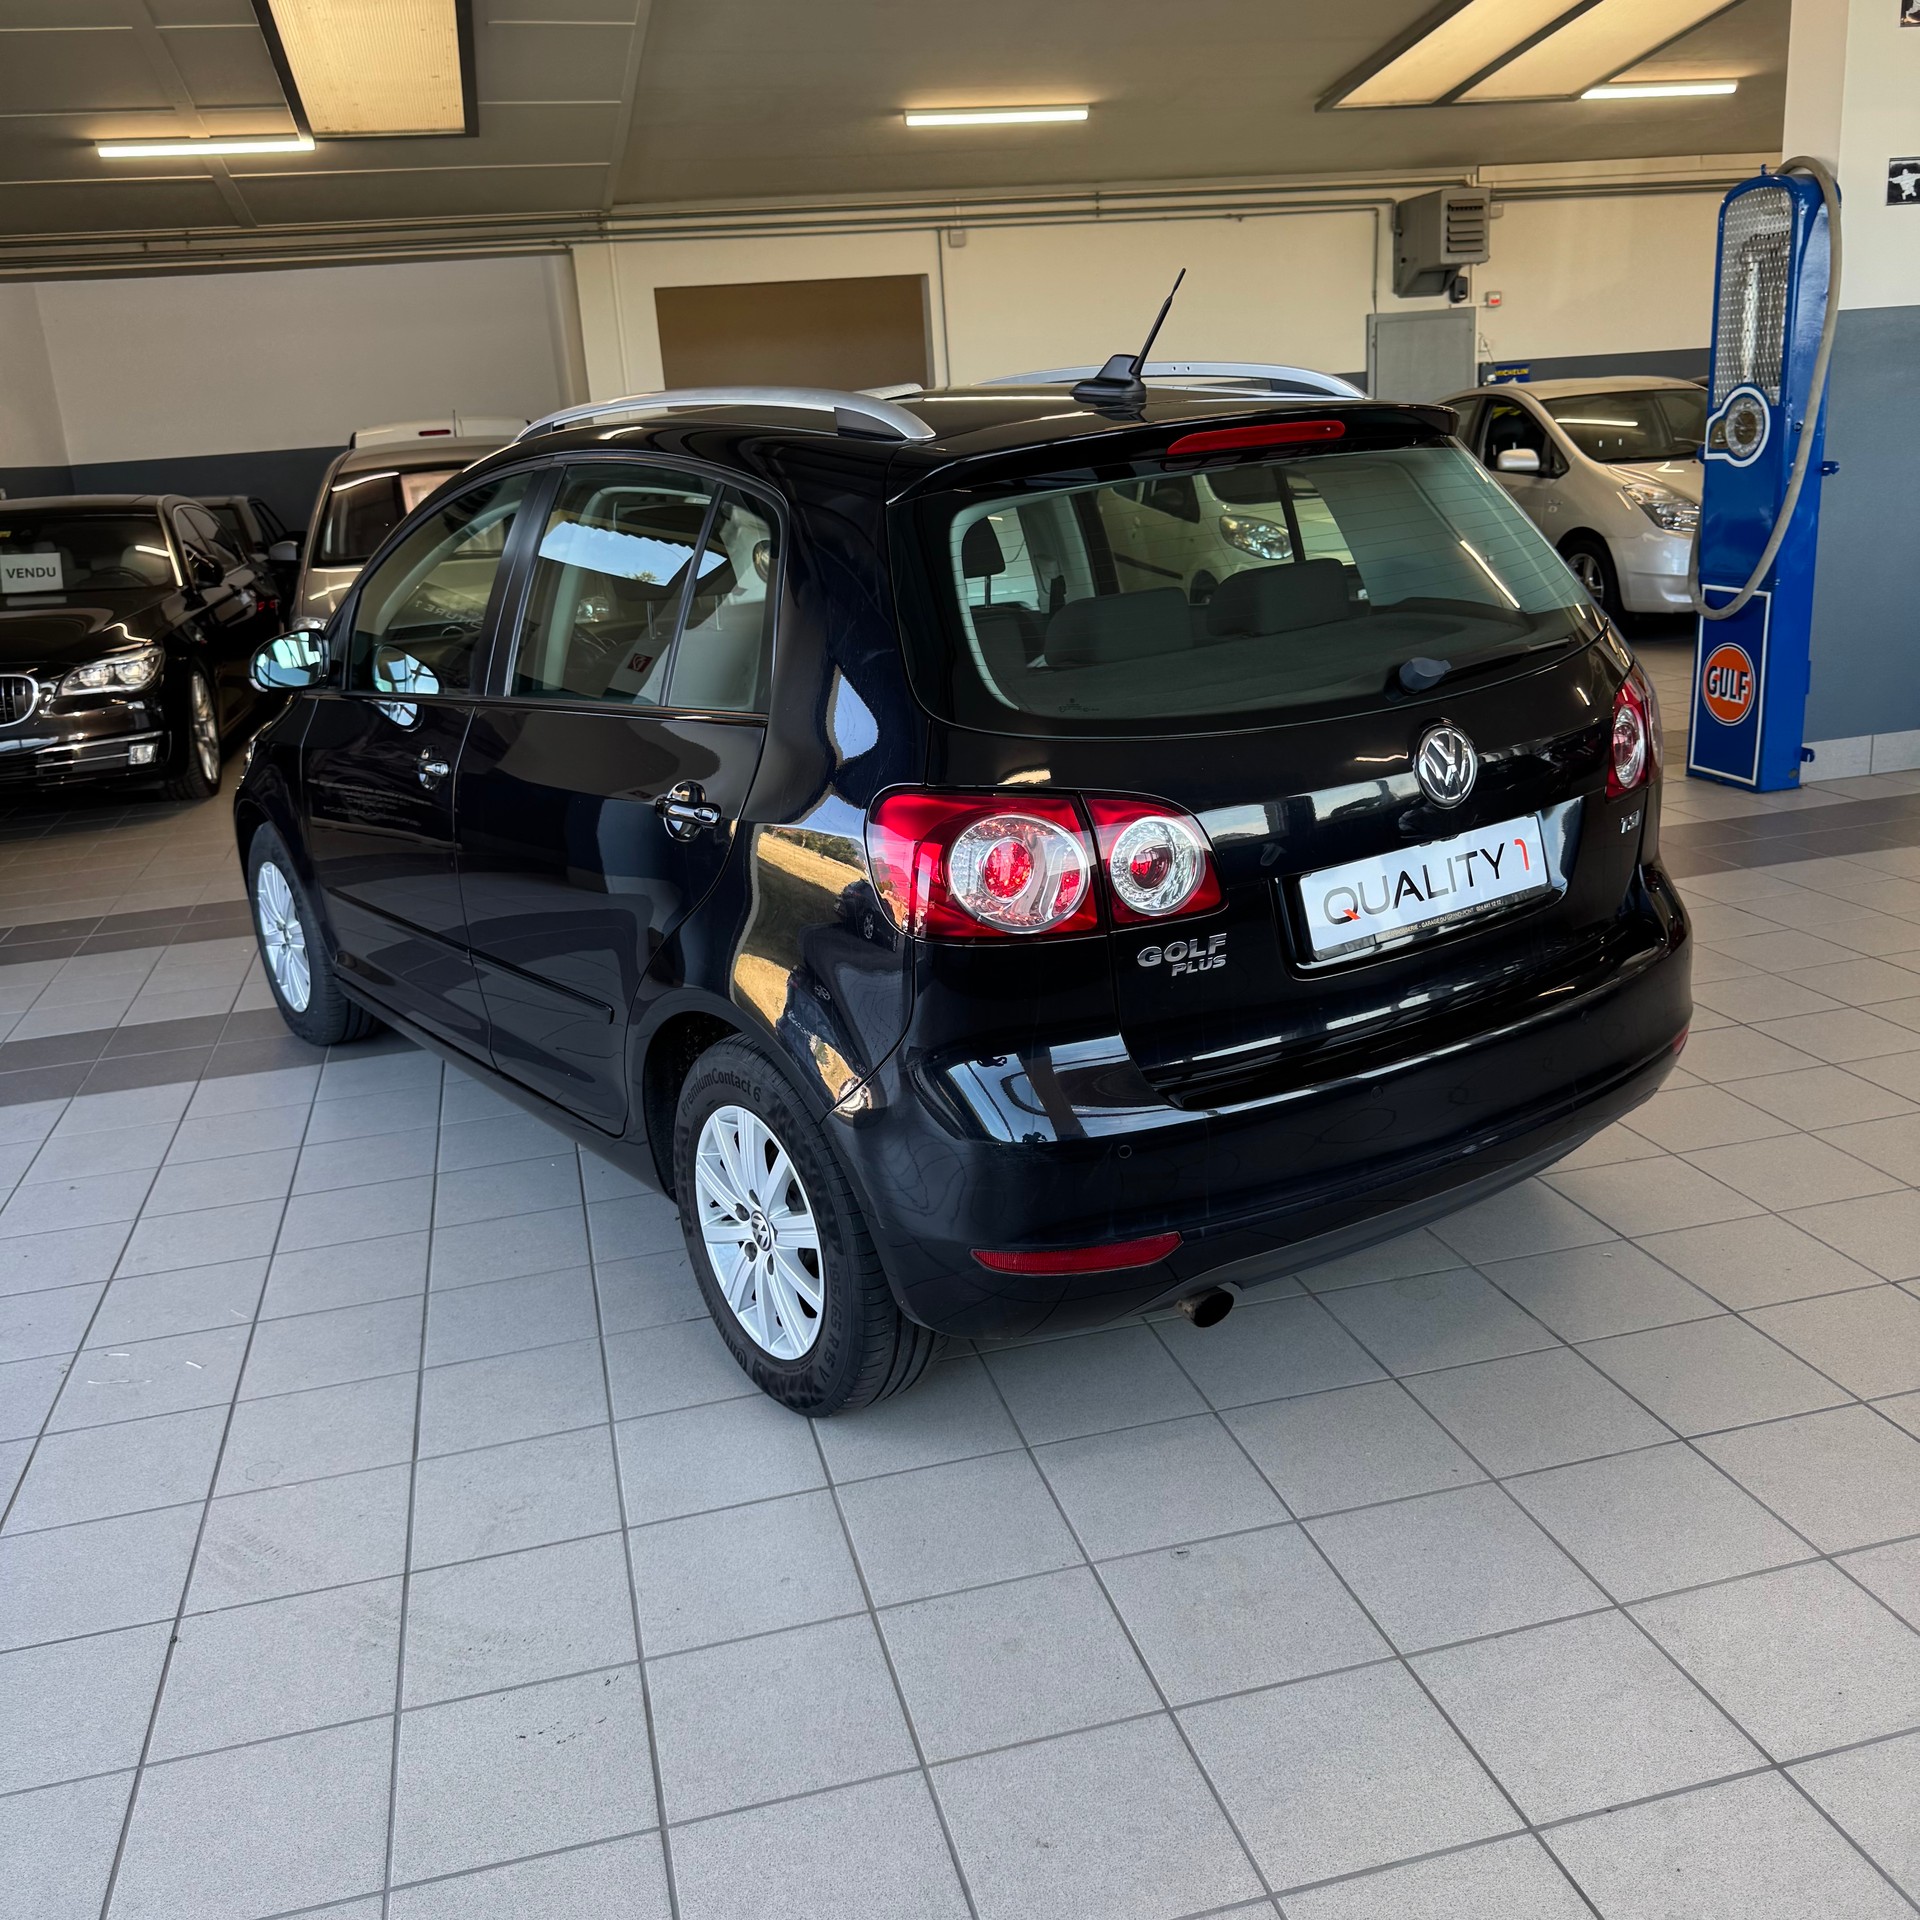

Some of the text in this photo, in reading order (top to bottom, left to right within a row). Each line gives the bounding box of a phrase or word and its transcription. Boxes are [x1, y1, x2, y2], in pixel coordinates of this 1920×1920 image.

[6, 566, 57, 579] VENDU
[1707, 665, 1750, 705] GULF
[1323, 838, 1531, 926] QUALITY 1
[1137, 932, 1228, 967] GOLF
[1171, 954, 1227, 977] PLUS
[681, 1067, 763, 1117] PremiumContact 6
[827, 1260, 843, 1331] 195/65
